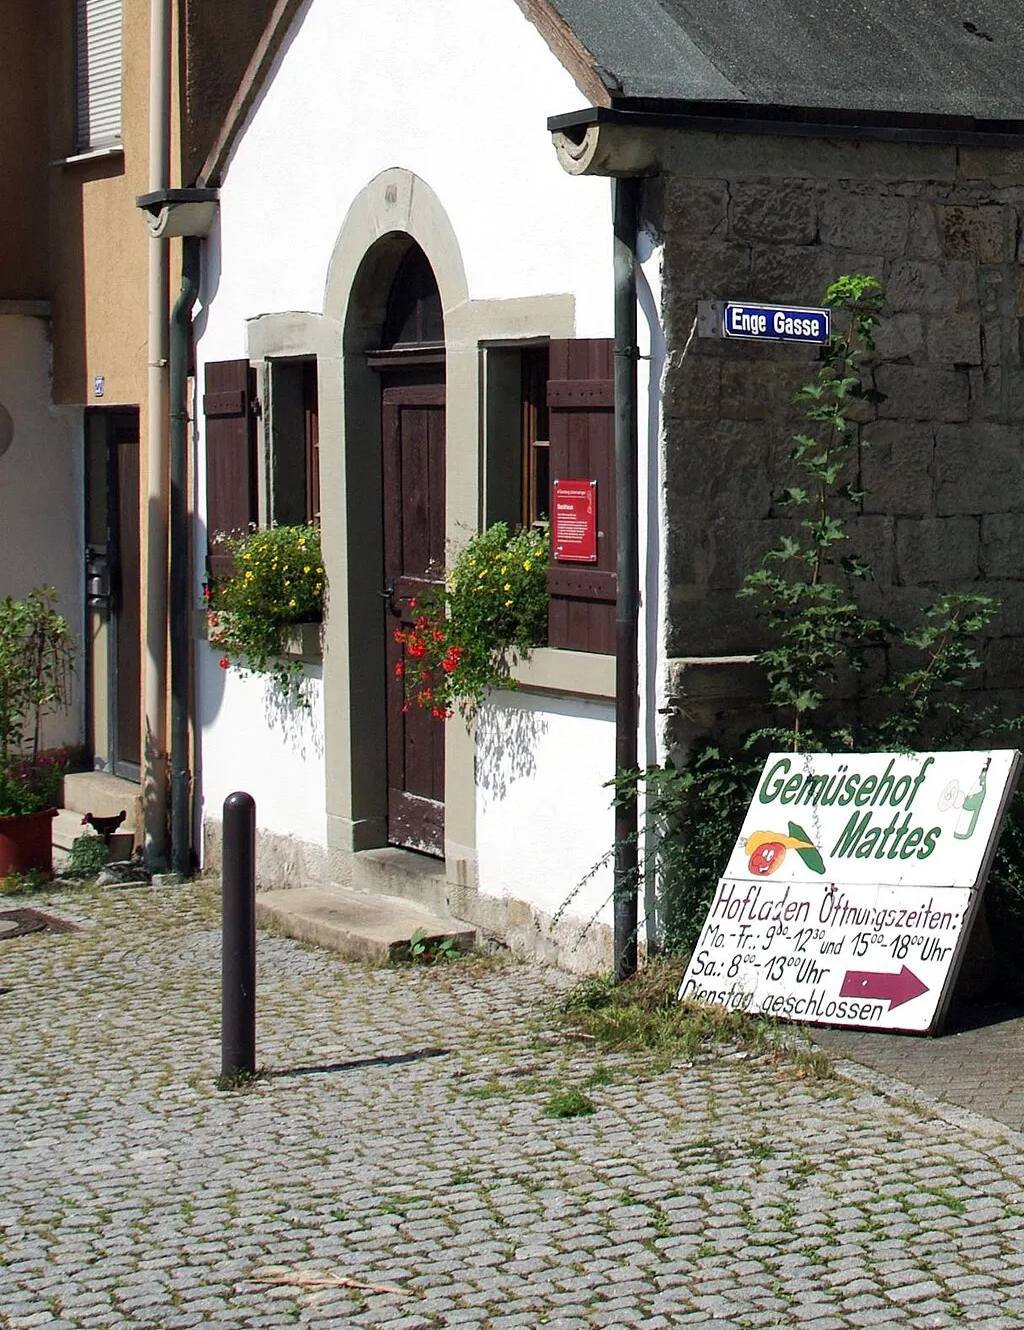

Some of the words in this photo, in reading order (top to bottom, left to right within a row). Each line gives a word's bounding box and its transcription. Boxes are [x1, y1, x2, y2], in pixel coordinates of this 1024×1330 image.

[732, 307, 767, 335] Enge
[773, 311, 820, 337] Gasse
[758, 756, 935, 812] Gemüsehof
[829, 810, 942, 860] Mattes
[711, 882, 811, 923] Hofladen
[820, 934, 847, 956] und
[919, 936, 953, 962] Uhr
[795, 957, 831, 984] Uhr
[761, 988, 884, 1022] geschlossen
